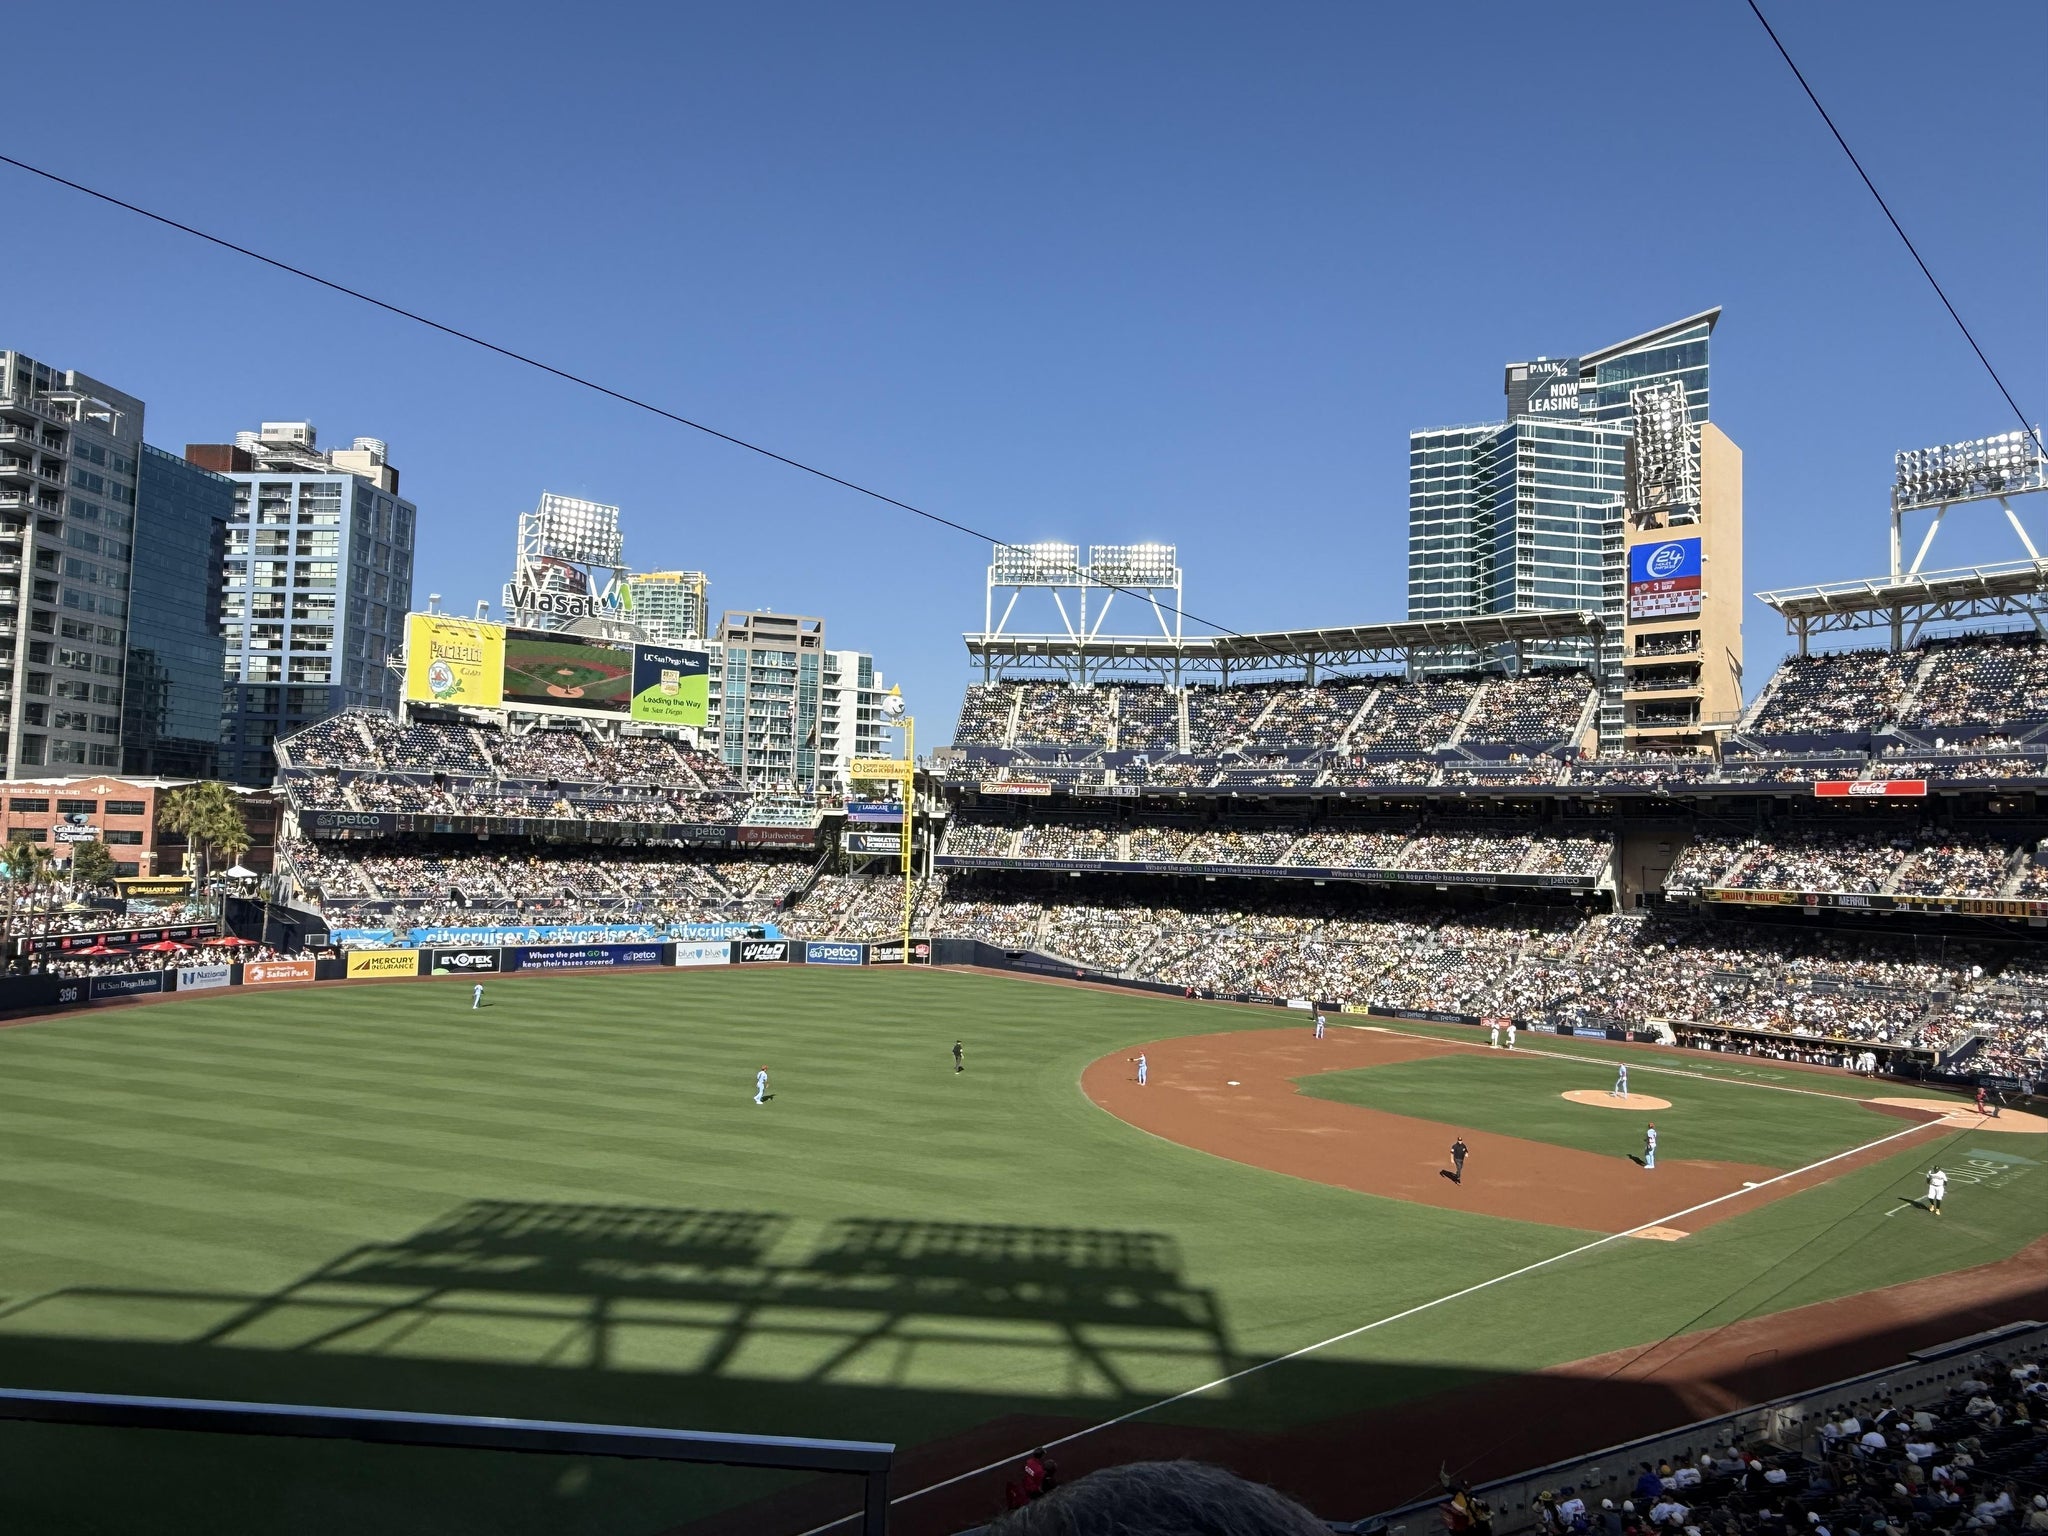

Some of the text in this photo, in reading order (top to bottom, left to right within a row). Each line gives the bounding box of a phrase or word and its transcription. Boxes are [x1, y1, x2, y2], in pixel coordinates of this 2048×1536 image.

[1529, 362, 1568, 377] PARK 12
[1550, 382, 1579, 397] NOW
[1528, 396, 1579, 413] LEASING
[1656, 549, 1682, 565] 24
[1653, 582, 1659, 591] 3
[510, 583, 598, 618] Viasat
[643, 696, 671, 706] Leading
[686, 700, 701, 709] Way
[337, 813, 380, 827] petco
[695, 827, 726, 837] petco
[761, 831, 805, 840] Budweiser
[1551, 876, 1580, 885] petco
[1827, 896, 1871, 907] 3 MERRILL
[549, 927, 637, 944] citycruise
[34, 941, 57, 949] TOOTA
[528, 951, 554, 959] Where
[569, 951, 586, 959] pets
[633, 951, 656, 961] petco
[678, 949, 696, 958] blue
[704, 948, 722, 957] blue
[824, 946, 858, 959] petco
[371, 957, 414, 965] MERCURY
[441, 953, 493, 967] EVOTEK
[522, 960, 542, 968] keep
[584, 958, 614, 966] covered
[266, 969, 309, 978] Safari Park
[59, 986, 78, 1002] 396
